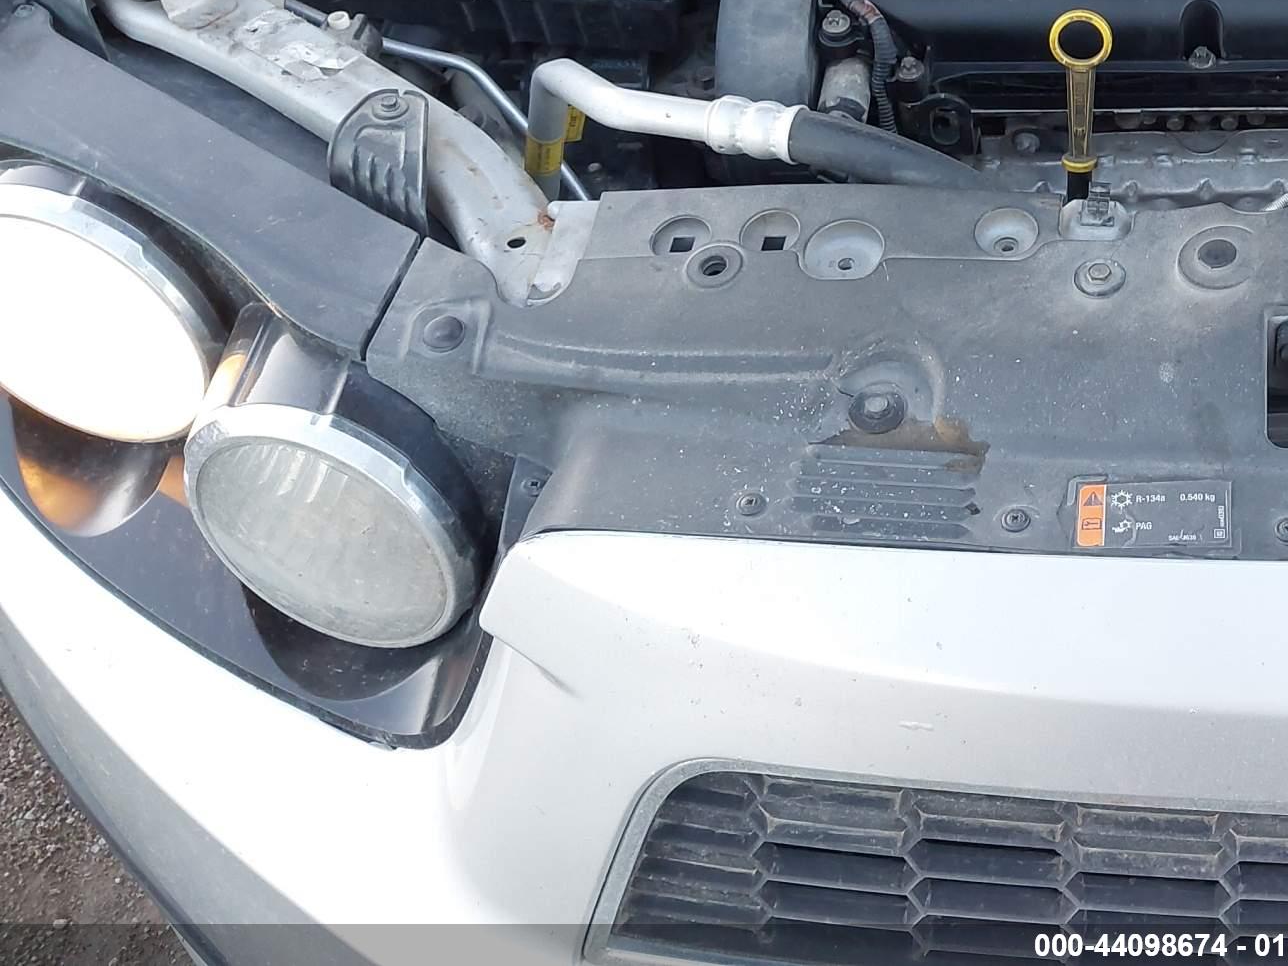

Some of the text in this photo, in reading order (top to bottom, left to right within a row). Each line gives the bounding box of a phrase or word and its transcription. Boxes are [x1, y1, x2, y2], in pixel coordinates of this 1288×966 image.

[1135, 493, 1216, 502] R-134a 0.540 kg
[1135, 522, 1153, 530] PAG
